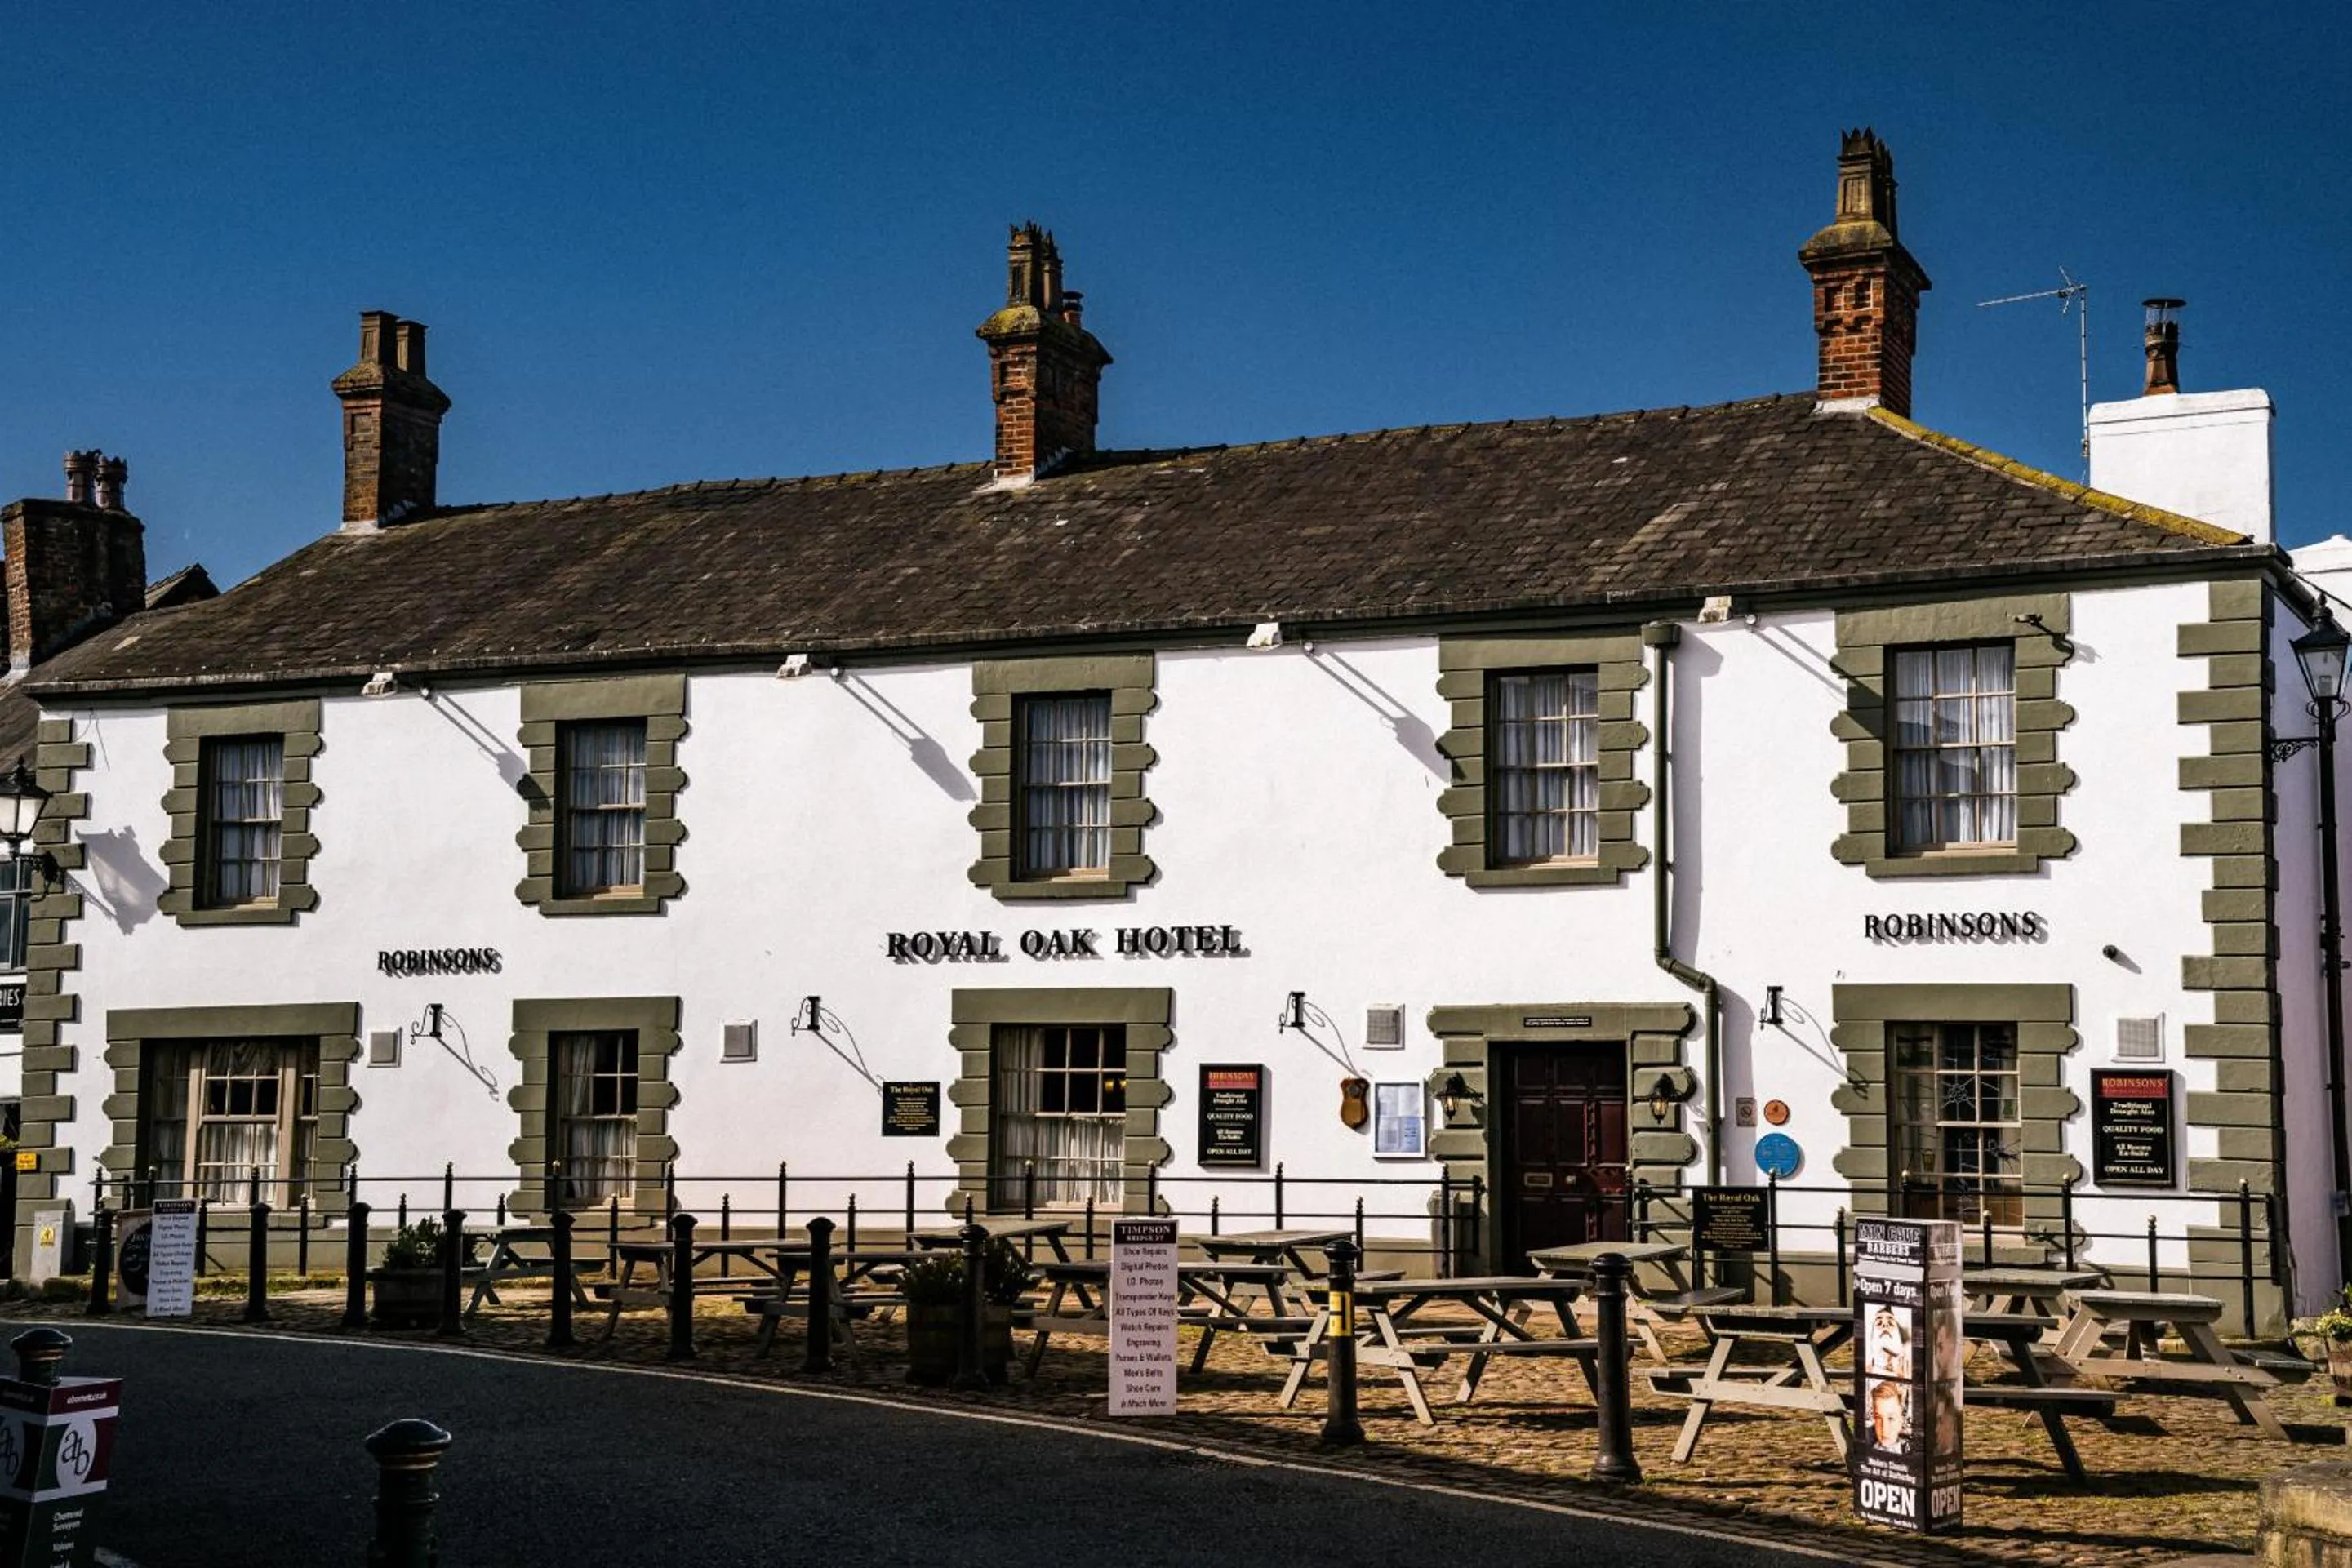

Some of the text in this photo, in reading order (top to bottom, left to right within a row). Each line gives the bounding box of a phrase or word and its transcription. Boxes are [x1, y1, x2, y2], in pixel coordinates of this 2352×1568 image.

[1865, 910, 2038, 940] ROBINSONS
[887, 925, 1242, 957] ROYAL OAK HOTEL
[377, 947, 495, 971] ROBINSONS
[2102, 1078, 2163, 1087] ROBINSONS
[1207, 1113, 1254, 1121] QUALITY FOOD
[2102, 1125, 2165, 1135] QUALITY FOOD
[1207, 1148, 1225, 1156] OPEN
[2104, 1165, 2165, 1175] OPEN ALL DAY
[1704, 1193, 1761, 1203] The Royal Oak
[1120, 1225, 1172, 1235] TIMPSON
[1123, 1247, 1168, 1258] Shoe Repairs
[1866, 1242, 1910, 1257] BARBERS
[1120, 1262, 1169, 1273] Digital Photos
[1860, 1277, 1883, 1295] Open
[1884, 1281, 1892, 1295] 7
[1860, 1478, 1916, 1518] OPEN
[1931, 1484, 1960, 1519] OPEN
